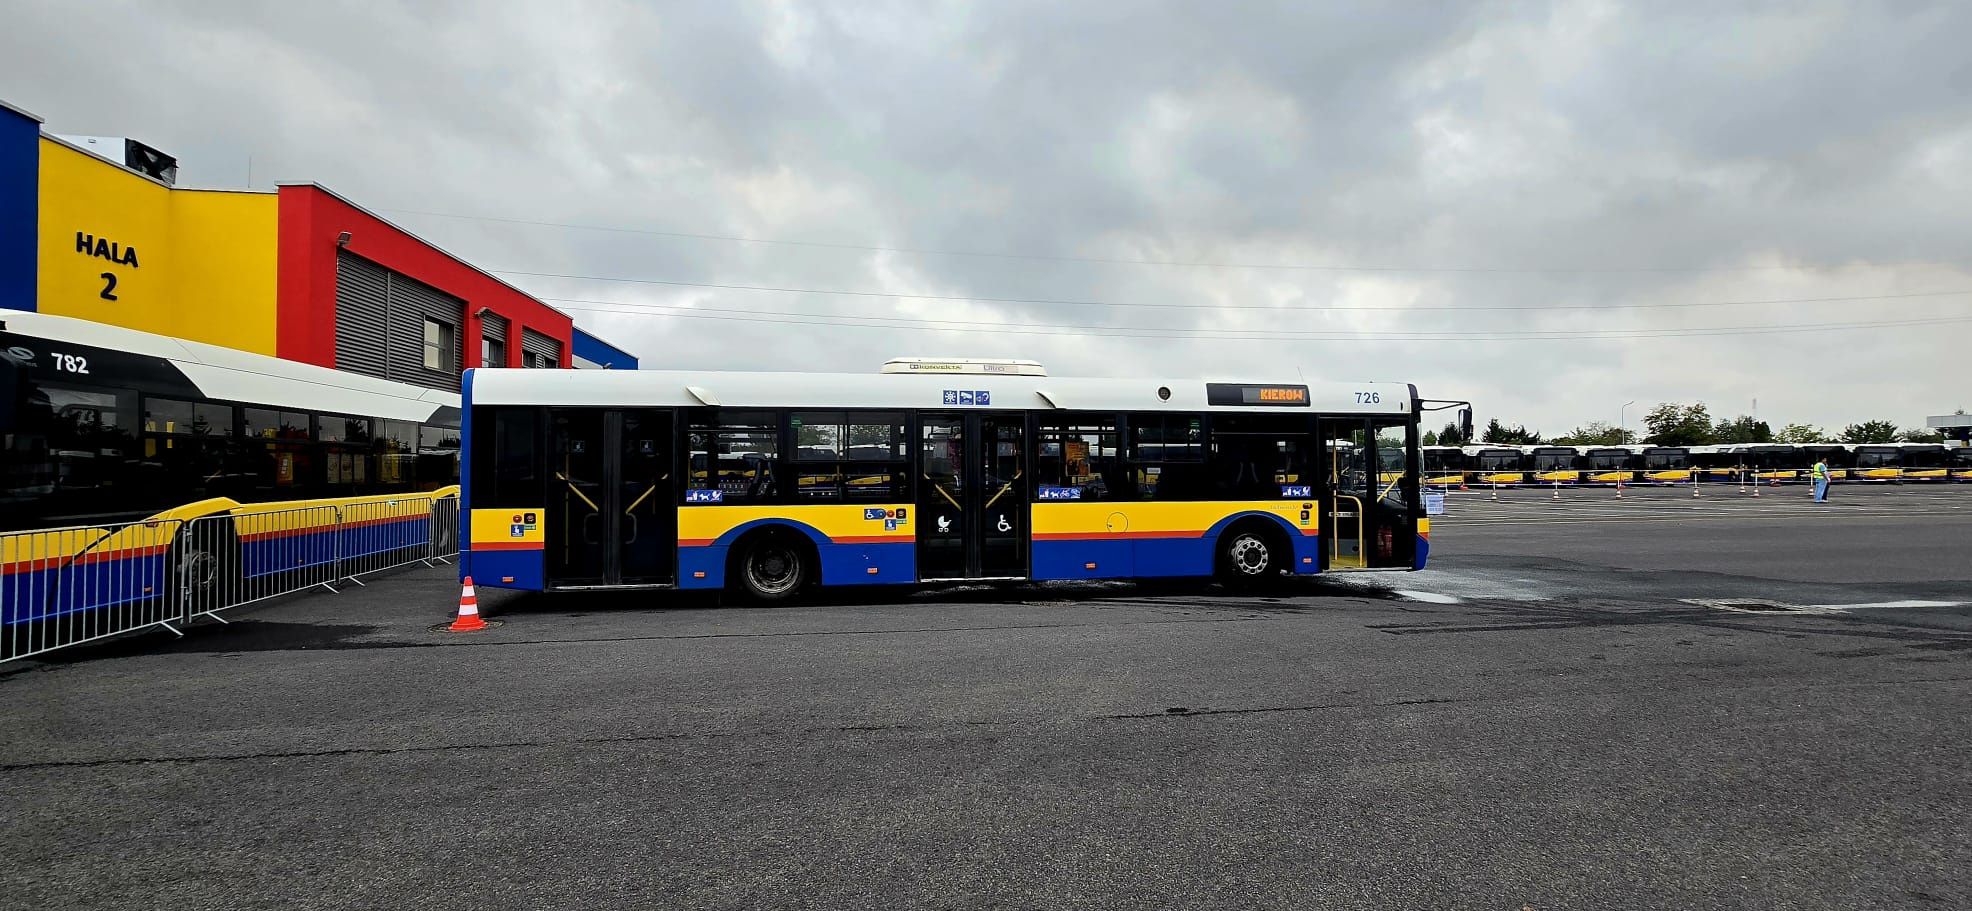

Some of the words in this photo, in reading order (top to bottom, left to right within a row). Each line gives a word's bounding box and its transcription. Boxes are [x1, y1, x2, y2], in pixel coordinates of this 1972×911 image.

[76, 231, 138, 268] HALA
[100, 272, 117, 301] 2
[51, 352, 89, 374] 782
[1260, 388, 1303, 401] KIEROW
[1354, 392, 1380, 404] 726
